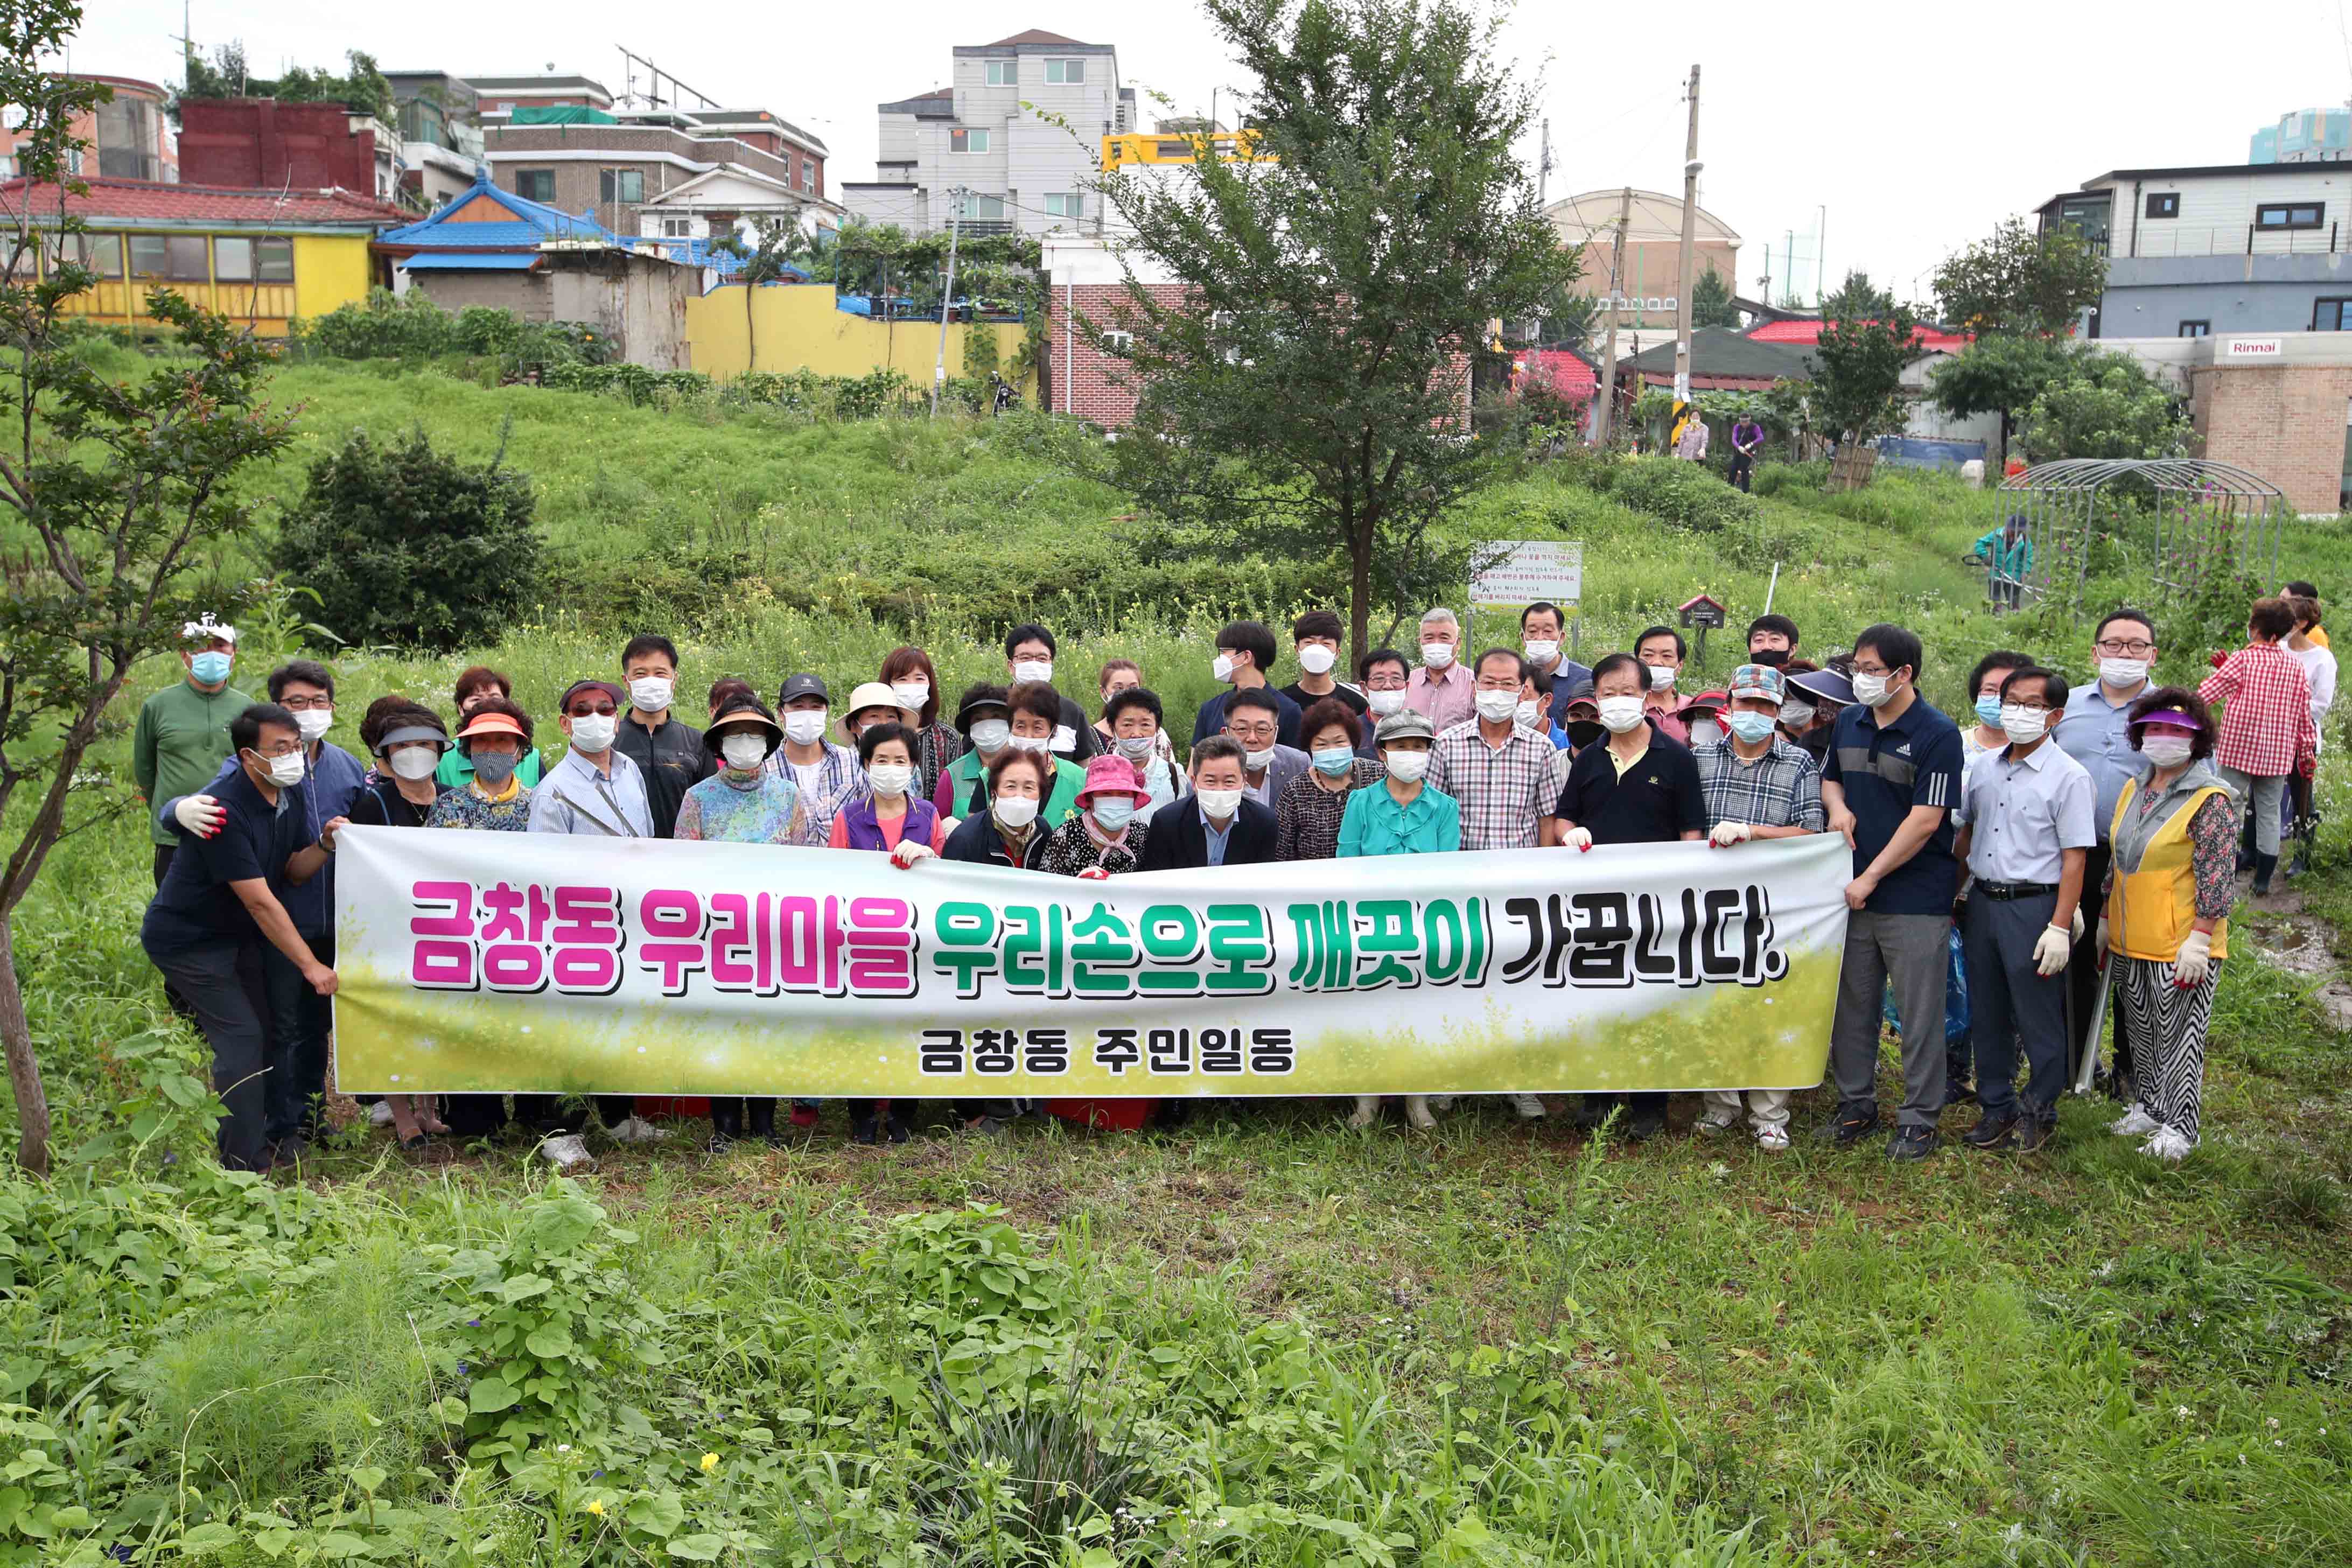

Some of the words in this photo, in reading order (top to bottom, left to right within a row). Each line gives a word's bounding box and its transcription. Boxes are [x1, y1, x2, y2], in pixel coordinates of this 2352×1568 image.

[2234, 342, 2276, 353] Rinnai
[410, 881, 619, 989] 금창동
[640, 889, 912, 991] 우리마을
[933, 901, 1269, 992] 우리손으로
[1287, 896, 1485, 989] 깨끗이
[1502, 884, 1781, 982] 가꿉니다.
[920, 1029, 1068, 1073] 금창동
[1095, 1028, 1293, 1073] 주민일동
